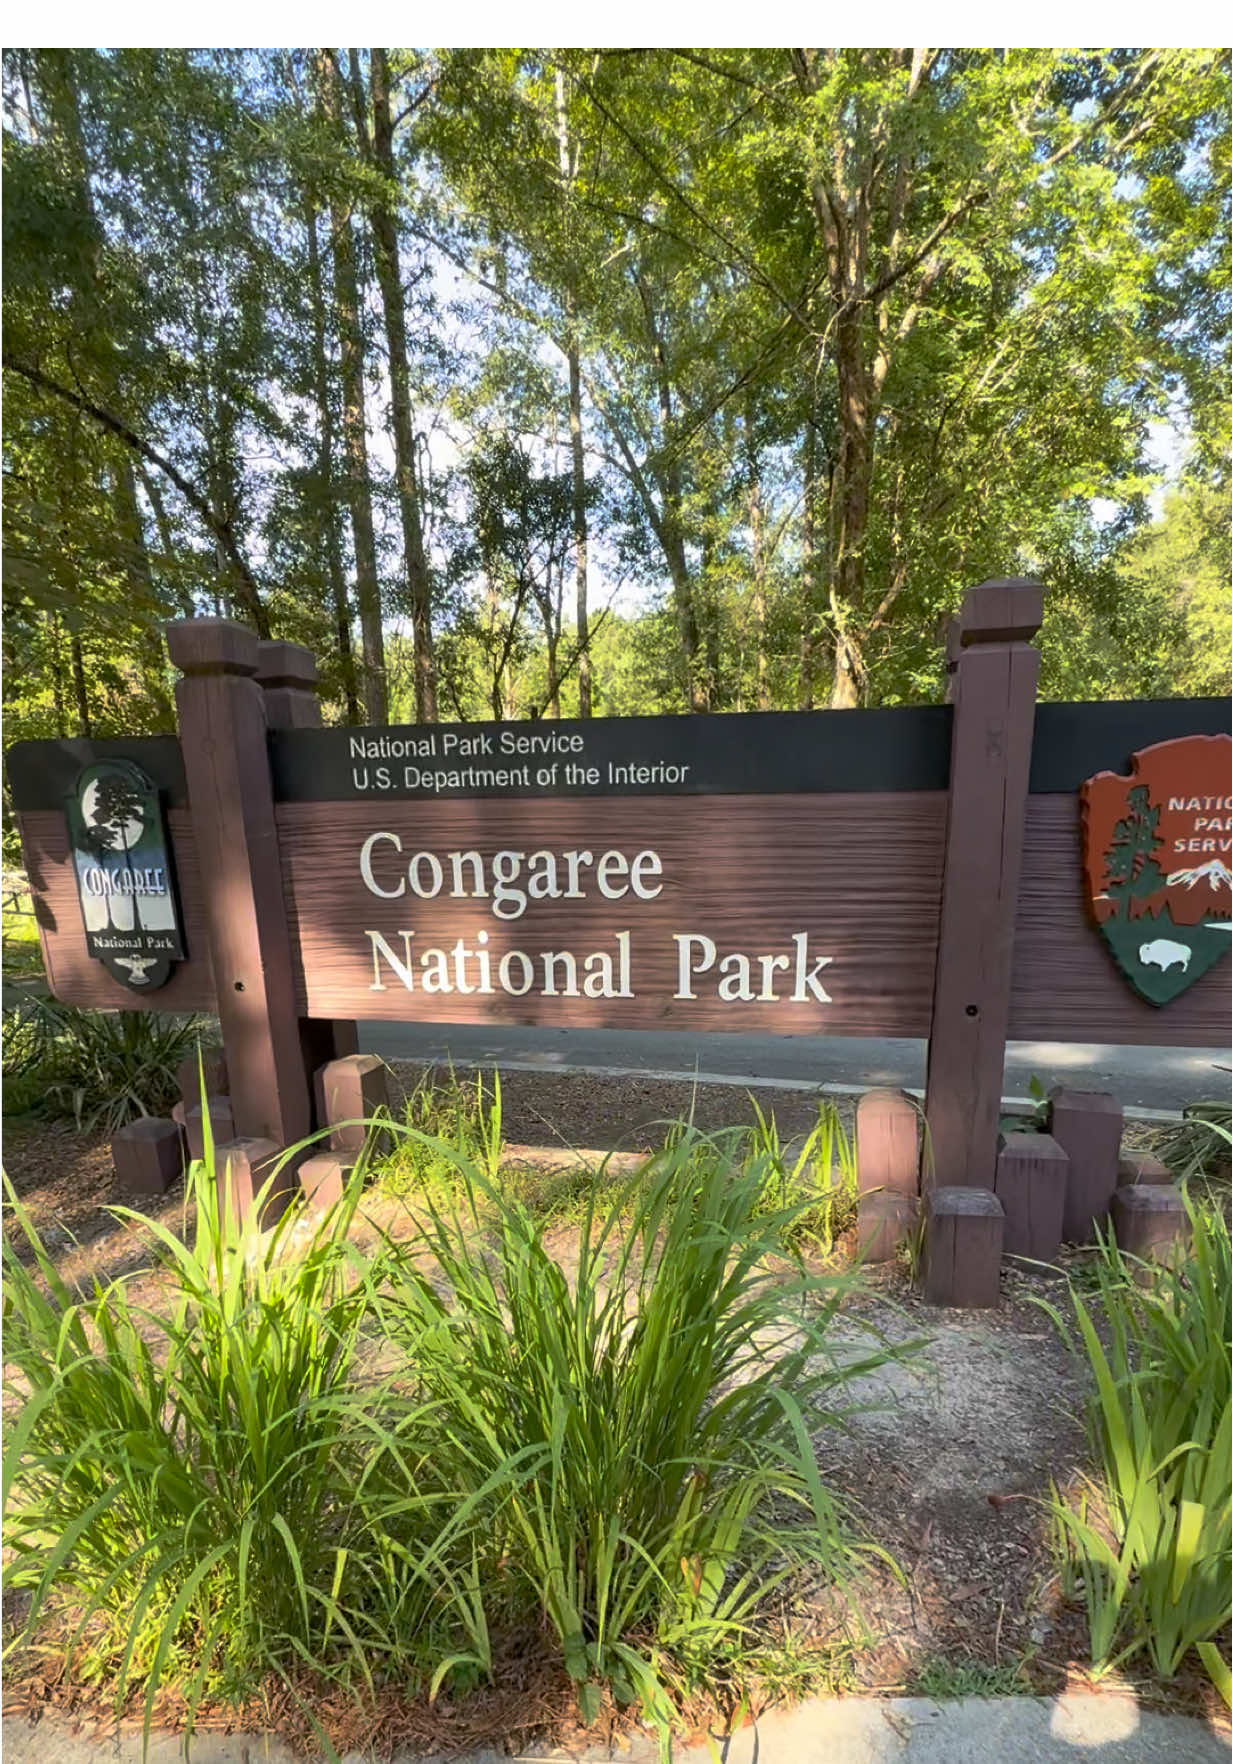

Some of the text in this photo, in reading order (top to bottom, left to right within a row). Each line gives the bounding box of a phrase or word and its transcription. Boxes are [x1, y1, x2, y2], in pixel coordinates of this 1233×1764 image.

[349, 730, 584, 759] National Park Service
[353, 760, 690, 792] U.S. Department of the Interior
[83, 867, 166, 897] CONGAREE
[360, 832, 663, 919] Congaree
[93, 936, 174, 949] National Park
[365, 930, 833, 1002] National Park
